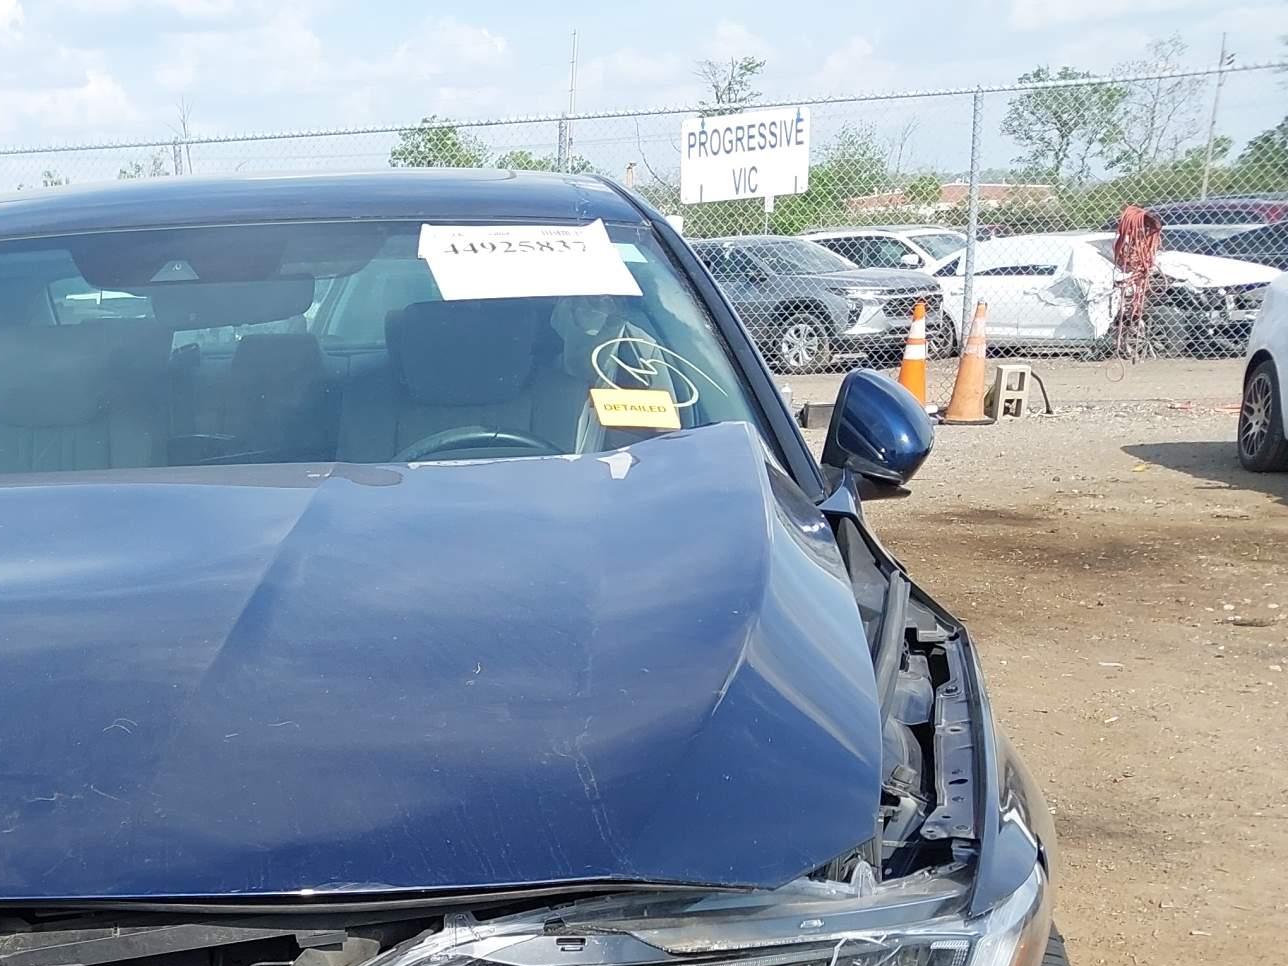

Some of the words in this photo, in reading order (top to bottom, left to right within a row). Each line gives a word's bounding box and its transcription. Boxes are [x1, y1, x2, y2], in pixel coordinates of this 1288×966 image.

[687, 118, 805, 160] PROGRESSIVE
[732, 166, 758, 195] VIC
[444, 239, 588, 255] 44925837
[603, 403, 667, 413] DETAILED
